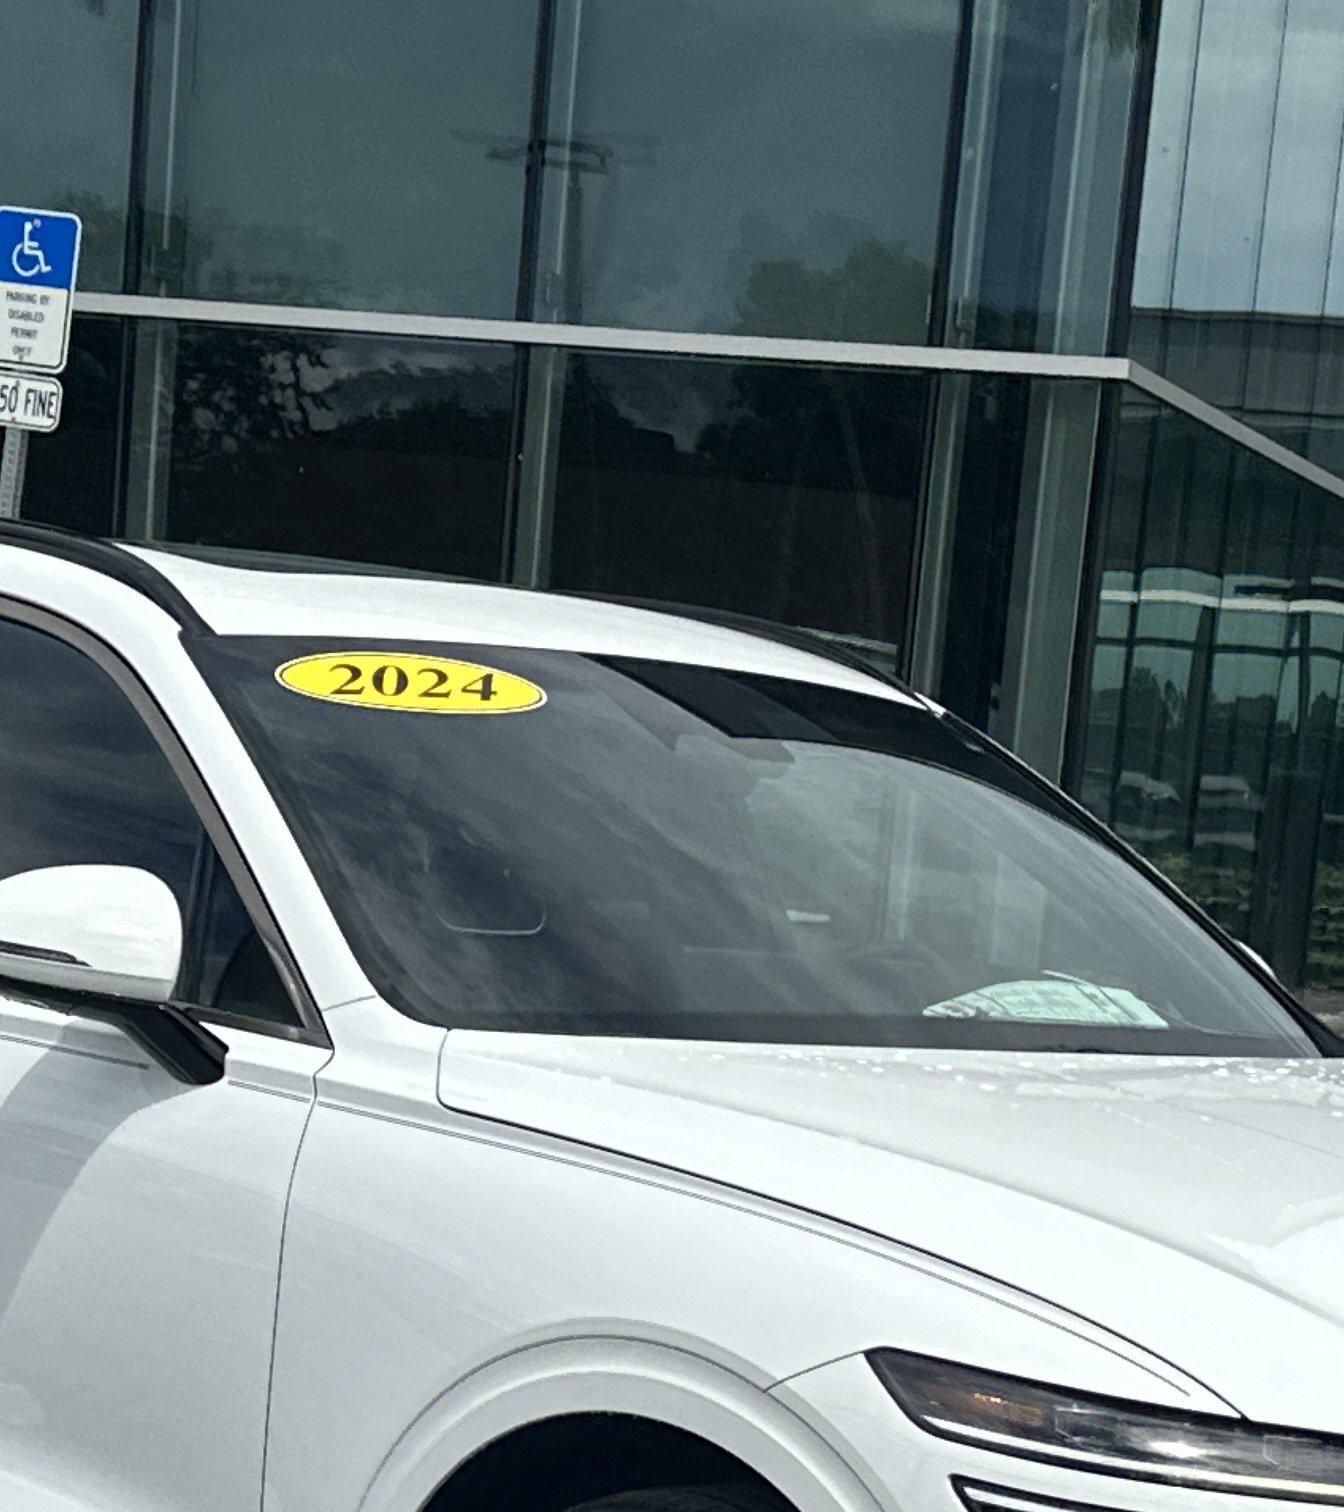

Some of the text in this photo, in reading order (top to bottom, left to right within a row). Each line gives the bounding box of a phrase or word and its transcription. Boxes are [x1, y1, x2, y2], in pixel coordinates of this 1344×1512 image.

[6, 291, 50, 305] PARKING BY
[8, 308, 44, 323] DISABLED
[11, 326, 38, 339] PERMIT
[24, 388, 57, 419] FINE
[329, 663, 498, 701] 2024
